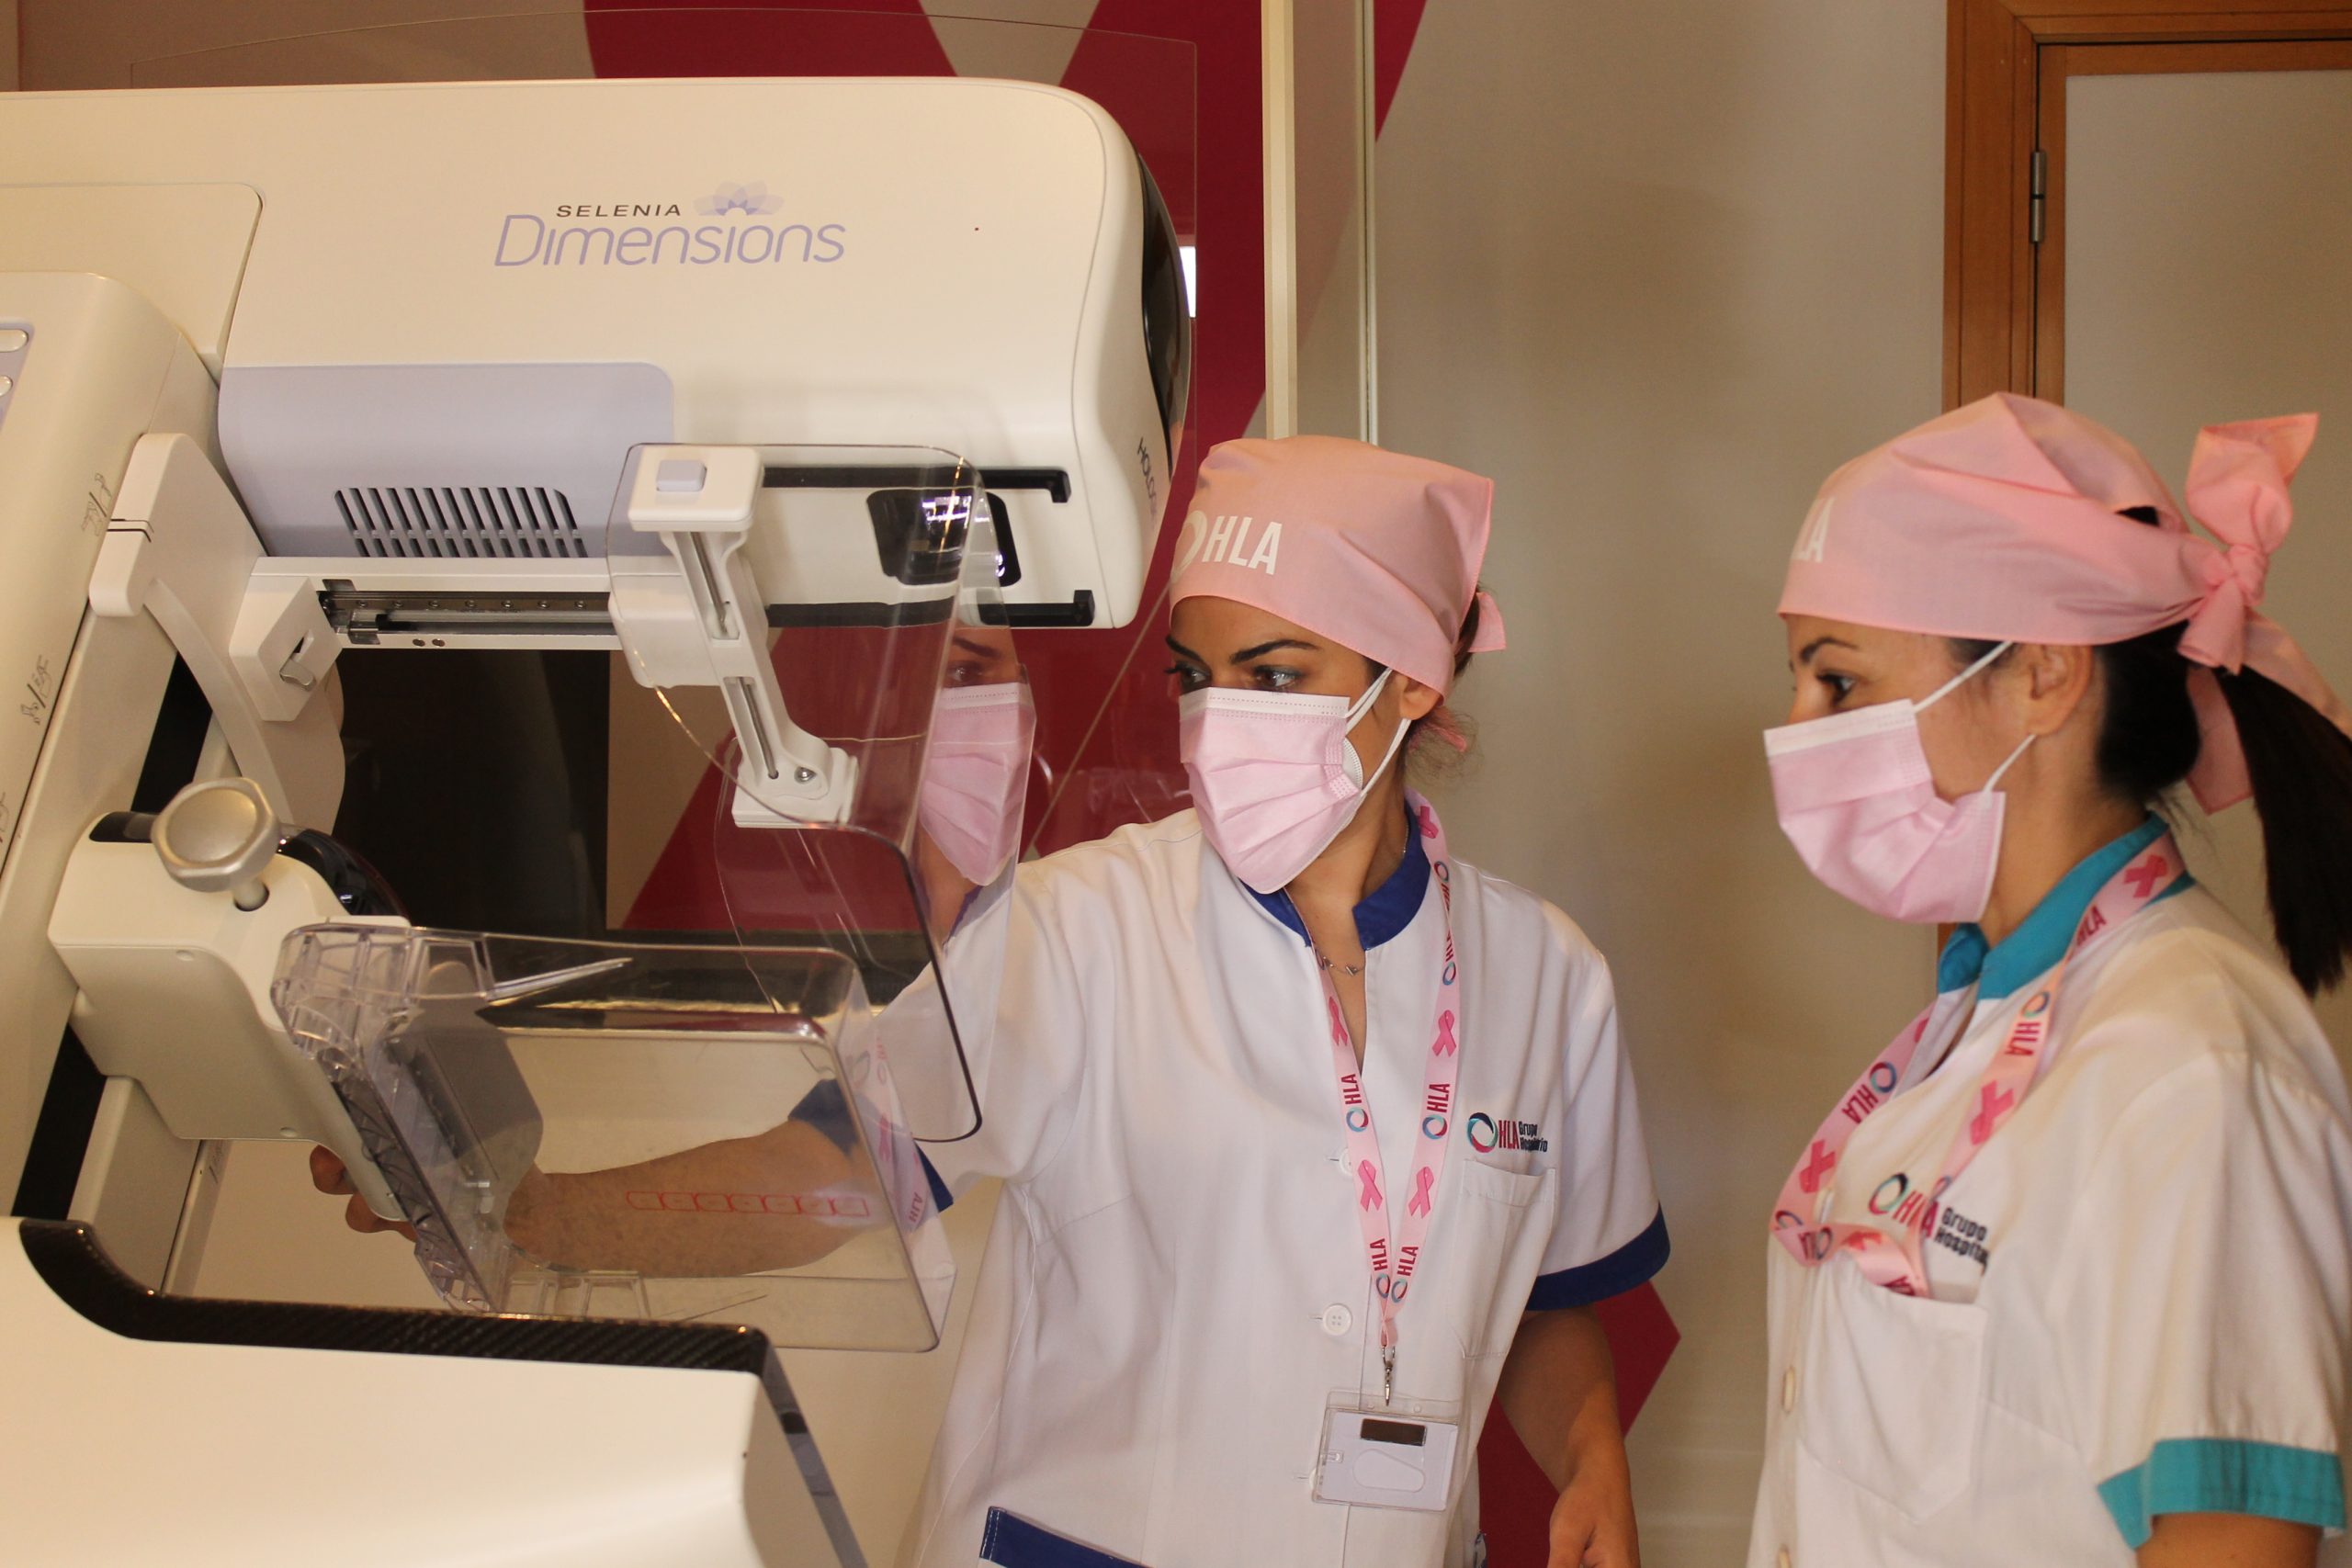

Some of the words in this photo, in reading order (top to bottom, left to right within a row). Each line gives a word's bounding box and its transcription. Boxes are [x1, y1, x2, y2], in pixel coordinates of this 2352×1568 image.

[555, 204, 682, 219] SELENIA
[494, 213, 846, 267] Dimensions
[1202, 515, 1283, 576] HLA
[2005, 1021, 2042, 1057] HLA
[1341, 1073, 1363, 1105] HLA
[1427, 1083, 1451, 1113] HLA
[1841, 1083, 1880, 1125] HLA
[1498, 1120, 1520, 1149] HLA
[1942, 1206, 1987, 1242] Grupo
[1369, 1237, 1388, 1271] HLA
[1396, 1246, 1419, 1277] HLA
